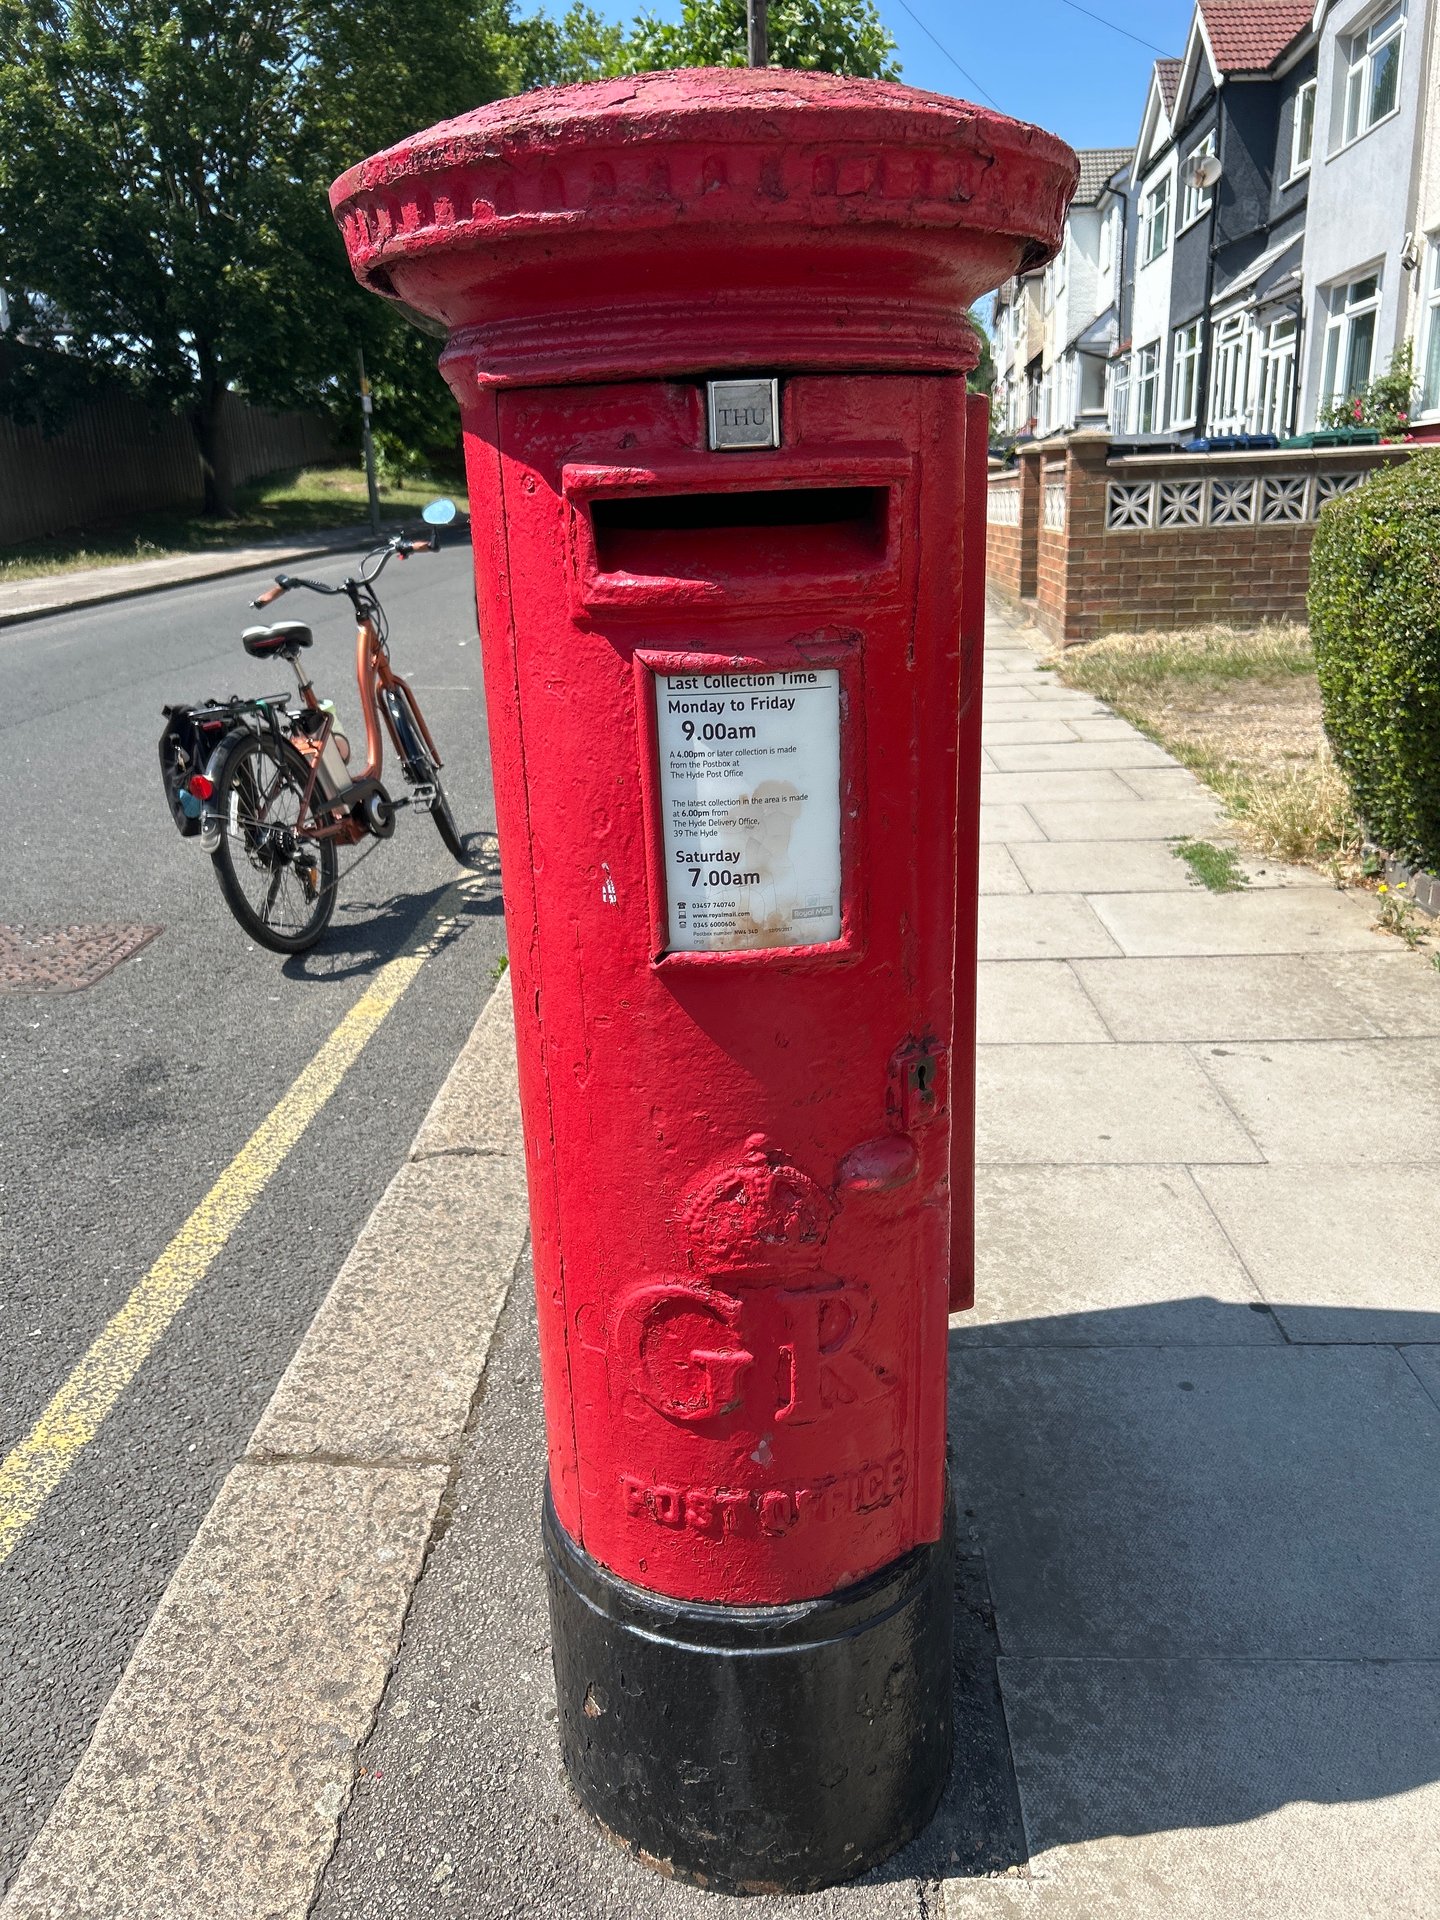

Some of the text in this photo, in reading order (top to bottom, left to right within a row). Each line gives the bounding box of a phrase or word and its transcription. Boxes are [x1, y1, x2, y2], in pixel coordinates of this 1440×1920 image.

[719, 408, 766, 426] THU
[667, 672, 817, 690] Last Collection Time
[668, 696, 796, 715] Monday to Friday
[681, 720, 756, 741] 9.00am
[677, 750, 705, 760] 4.00pm
[716, 749, 733, 757] later
[735, 748, 768, 757] collection
[769, 747, 775, 755] is
[777, 746, 797, 754] made
[670, 761, 687, 769] from
[702, 760, 731, 768] Postbox
[670, 769, 744, 780] The Hyde Post Office
[672, 800, 686, 808] The
[687, 799, 707, 807] latest
[708, 798, 741, 806] collection
[764, 796, 780, 804] area
[789, 793, 809, 802] made
[681, 810, 710, 818] 6.00pm
[673, 818, 760, 829] The Hyde Delivery Office,
[685, 829, 698, 837] The
[700, 829, 718, 838] Hyde
[676, 850, 740, 864] Saturday
[688, 867, 761, 888] 7.00am
[692, 911, 751, 920] www.royalmail.com
[794, 909, 815, 919] Royal
[621, 1473, 752, 1534] POST
